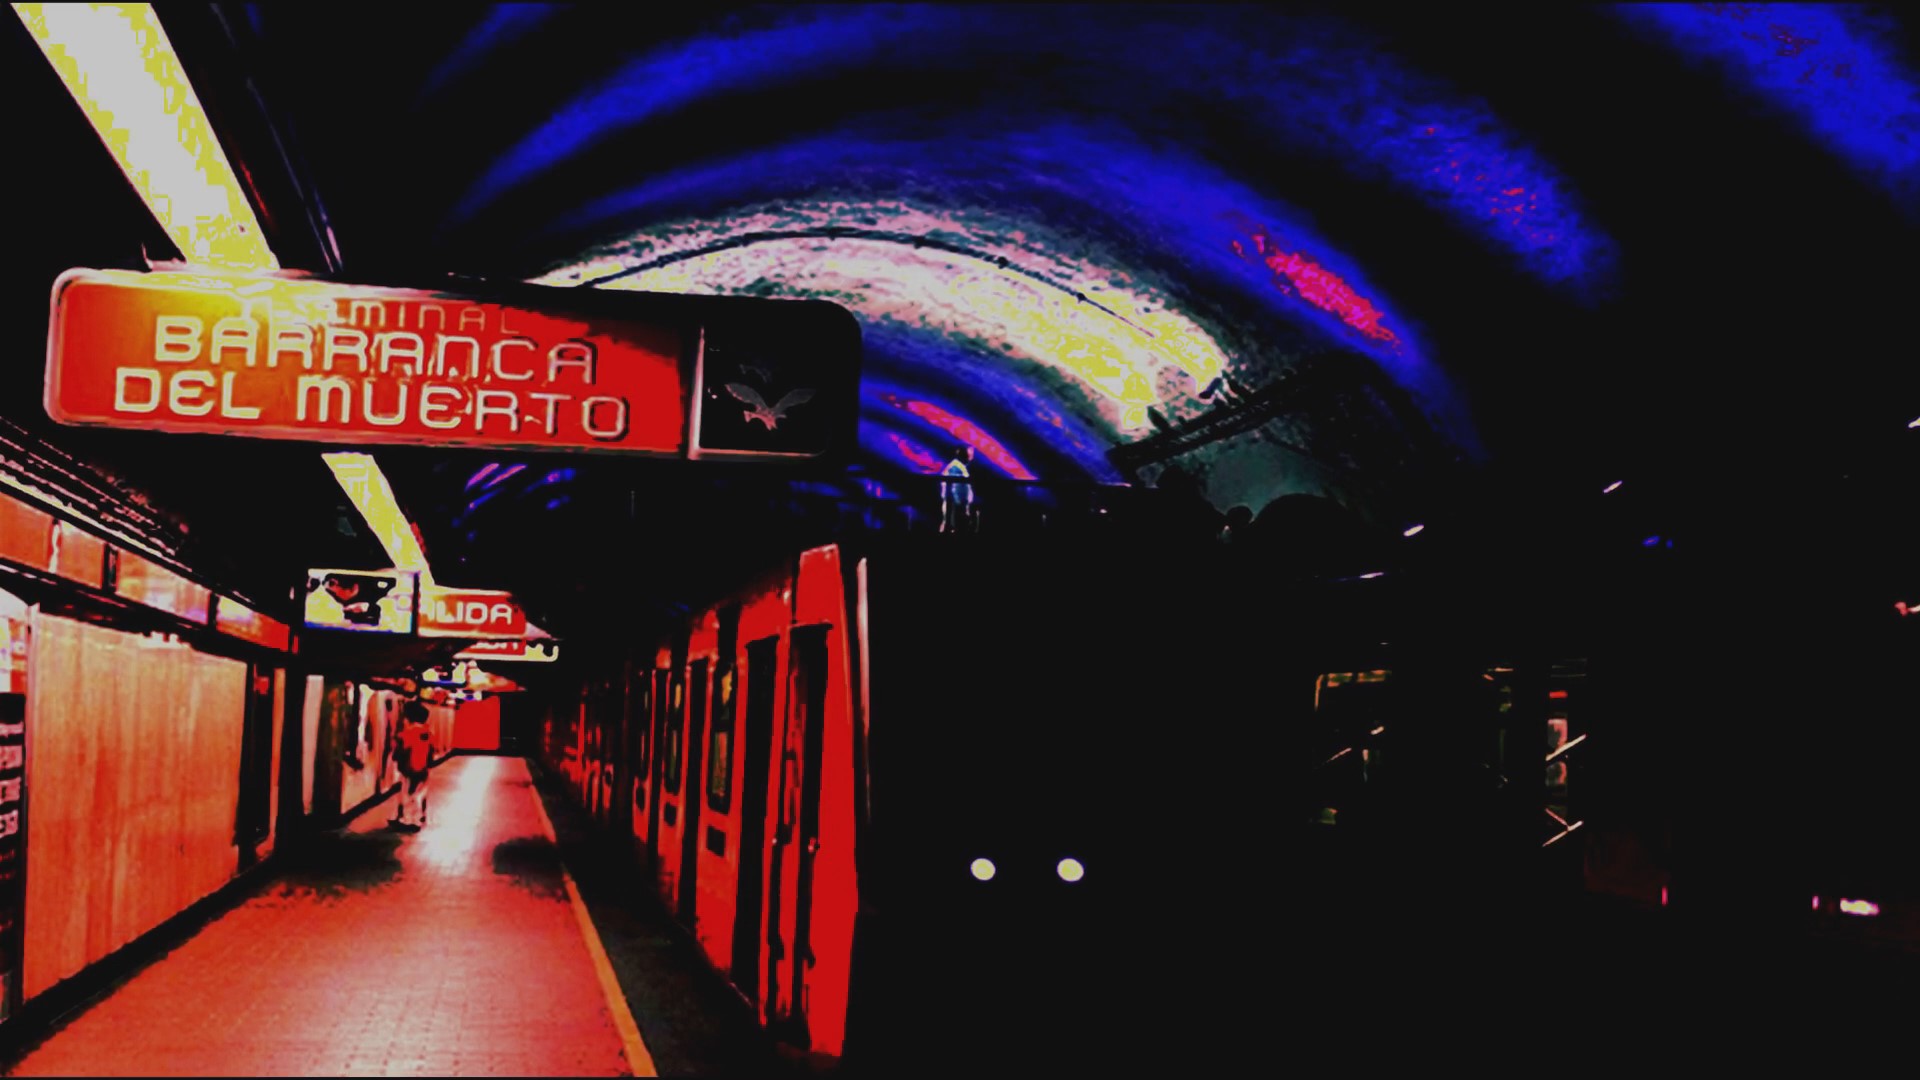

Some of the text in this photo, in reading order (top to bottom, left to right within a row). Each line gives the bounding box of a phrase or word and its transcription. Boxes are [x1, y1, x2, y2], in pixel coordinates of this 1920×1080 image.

[154, 315, 596, 384] BARRANCA
[114, 366, 628, 438] DEL MUERTO
